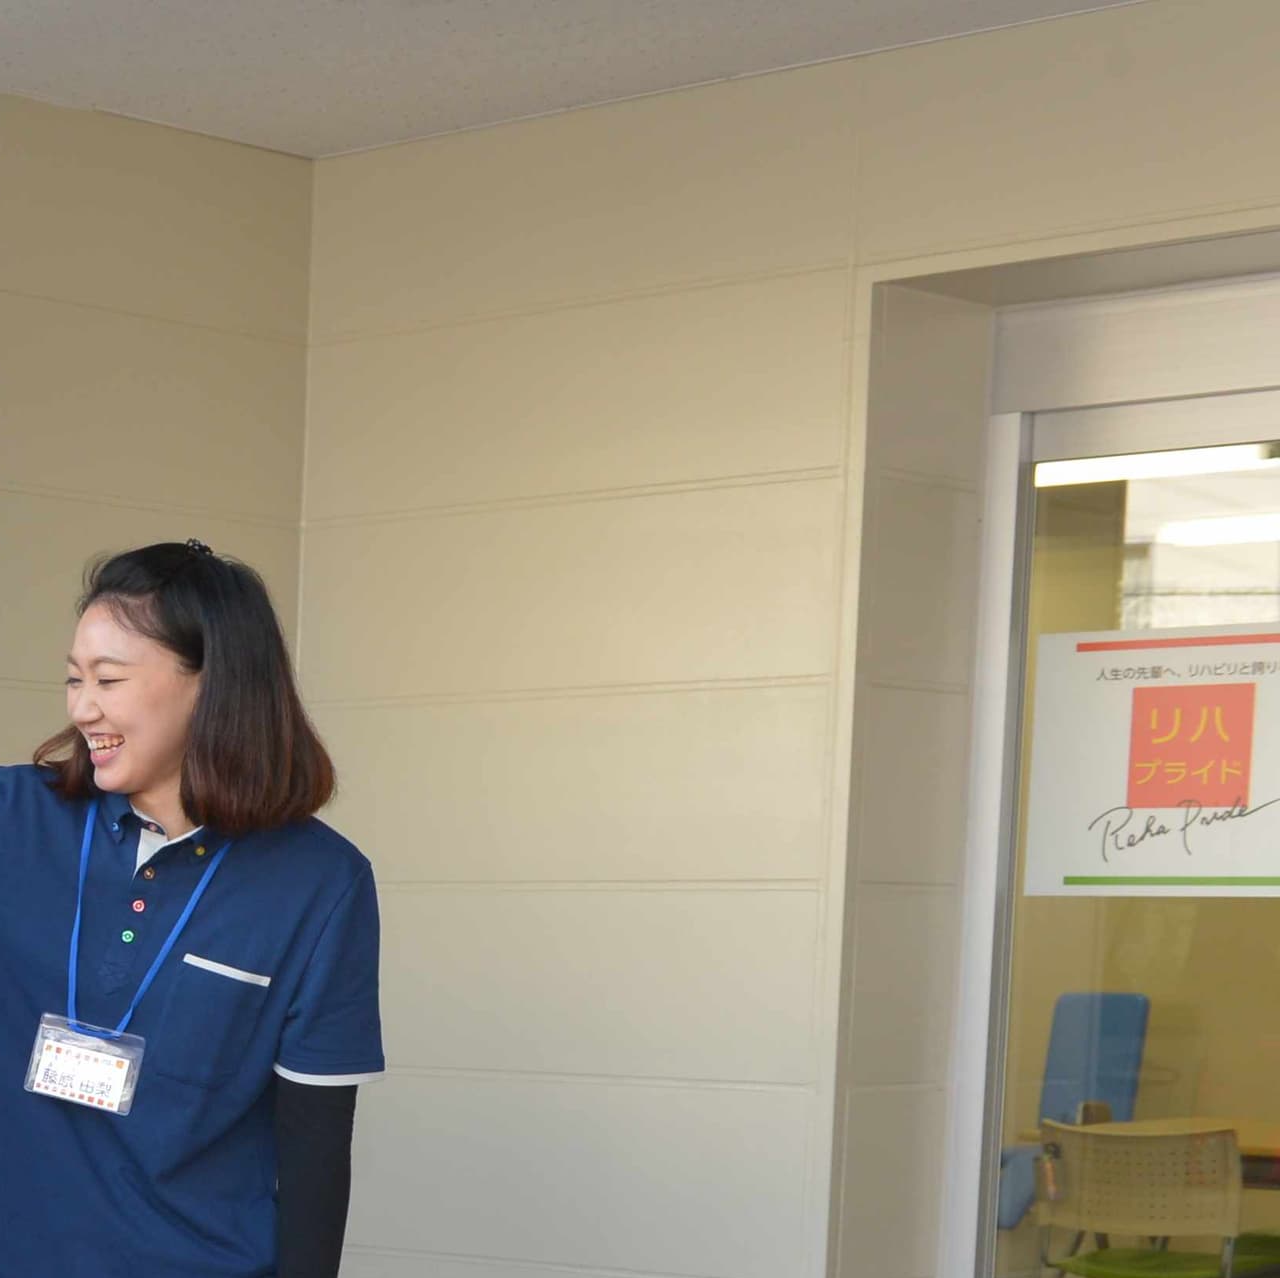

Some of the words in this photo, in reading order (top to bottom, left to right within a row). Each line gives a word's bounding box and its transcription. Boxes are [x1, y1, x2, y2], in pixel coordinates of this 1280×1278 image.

[1150, 705, 1230, 745] リハ
[1135, 758, 1243, 785] プライド
